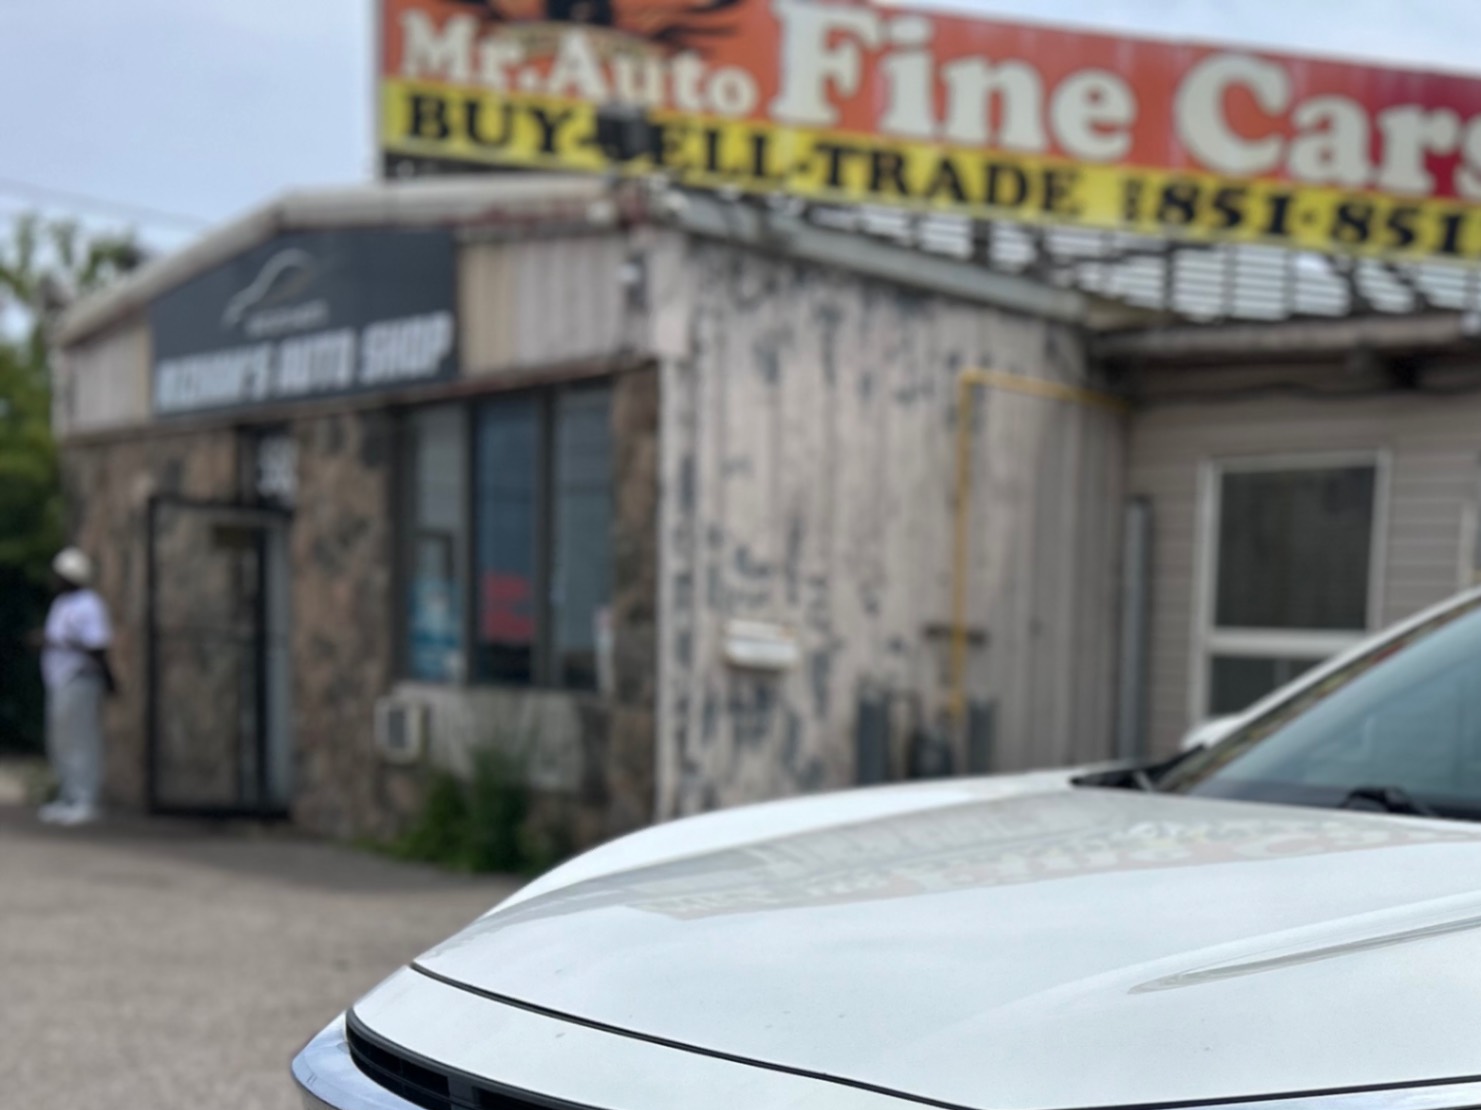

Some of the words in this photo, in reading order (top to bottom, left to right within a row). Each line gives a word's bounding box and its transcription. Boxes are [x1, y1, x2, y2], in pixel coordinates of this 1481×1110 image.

[770, 1, 1138, 162] Fine
[407, 92, 1083, 203] BUY-ELL-TRADE
[359, 311, 453, 385] SHOP
